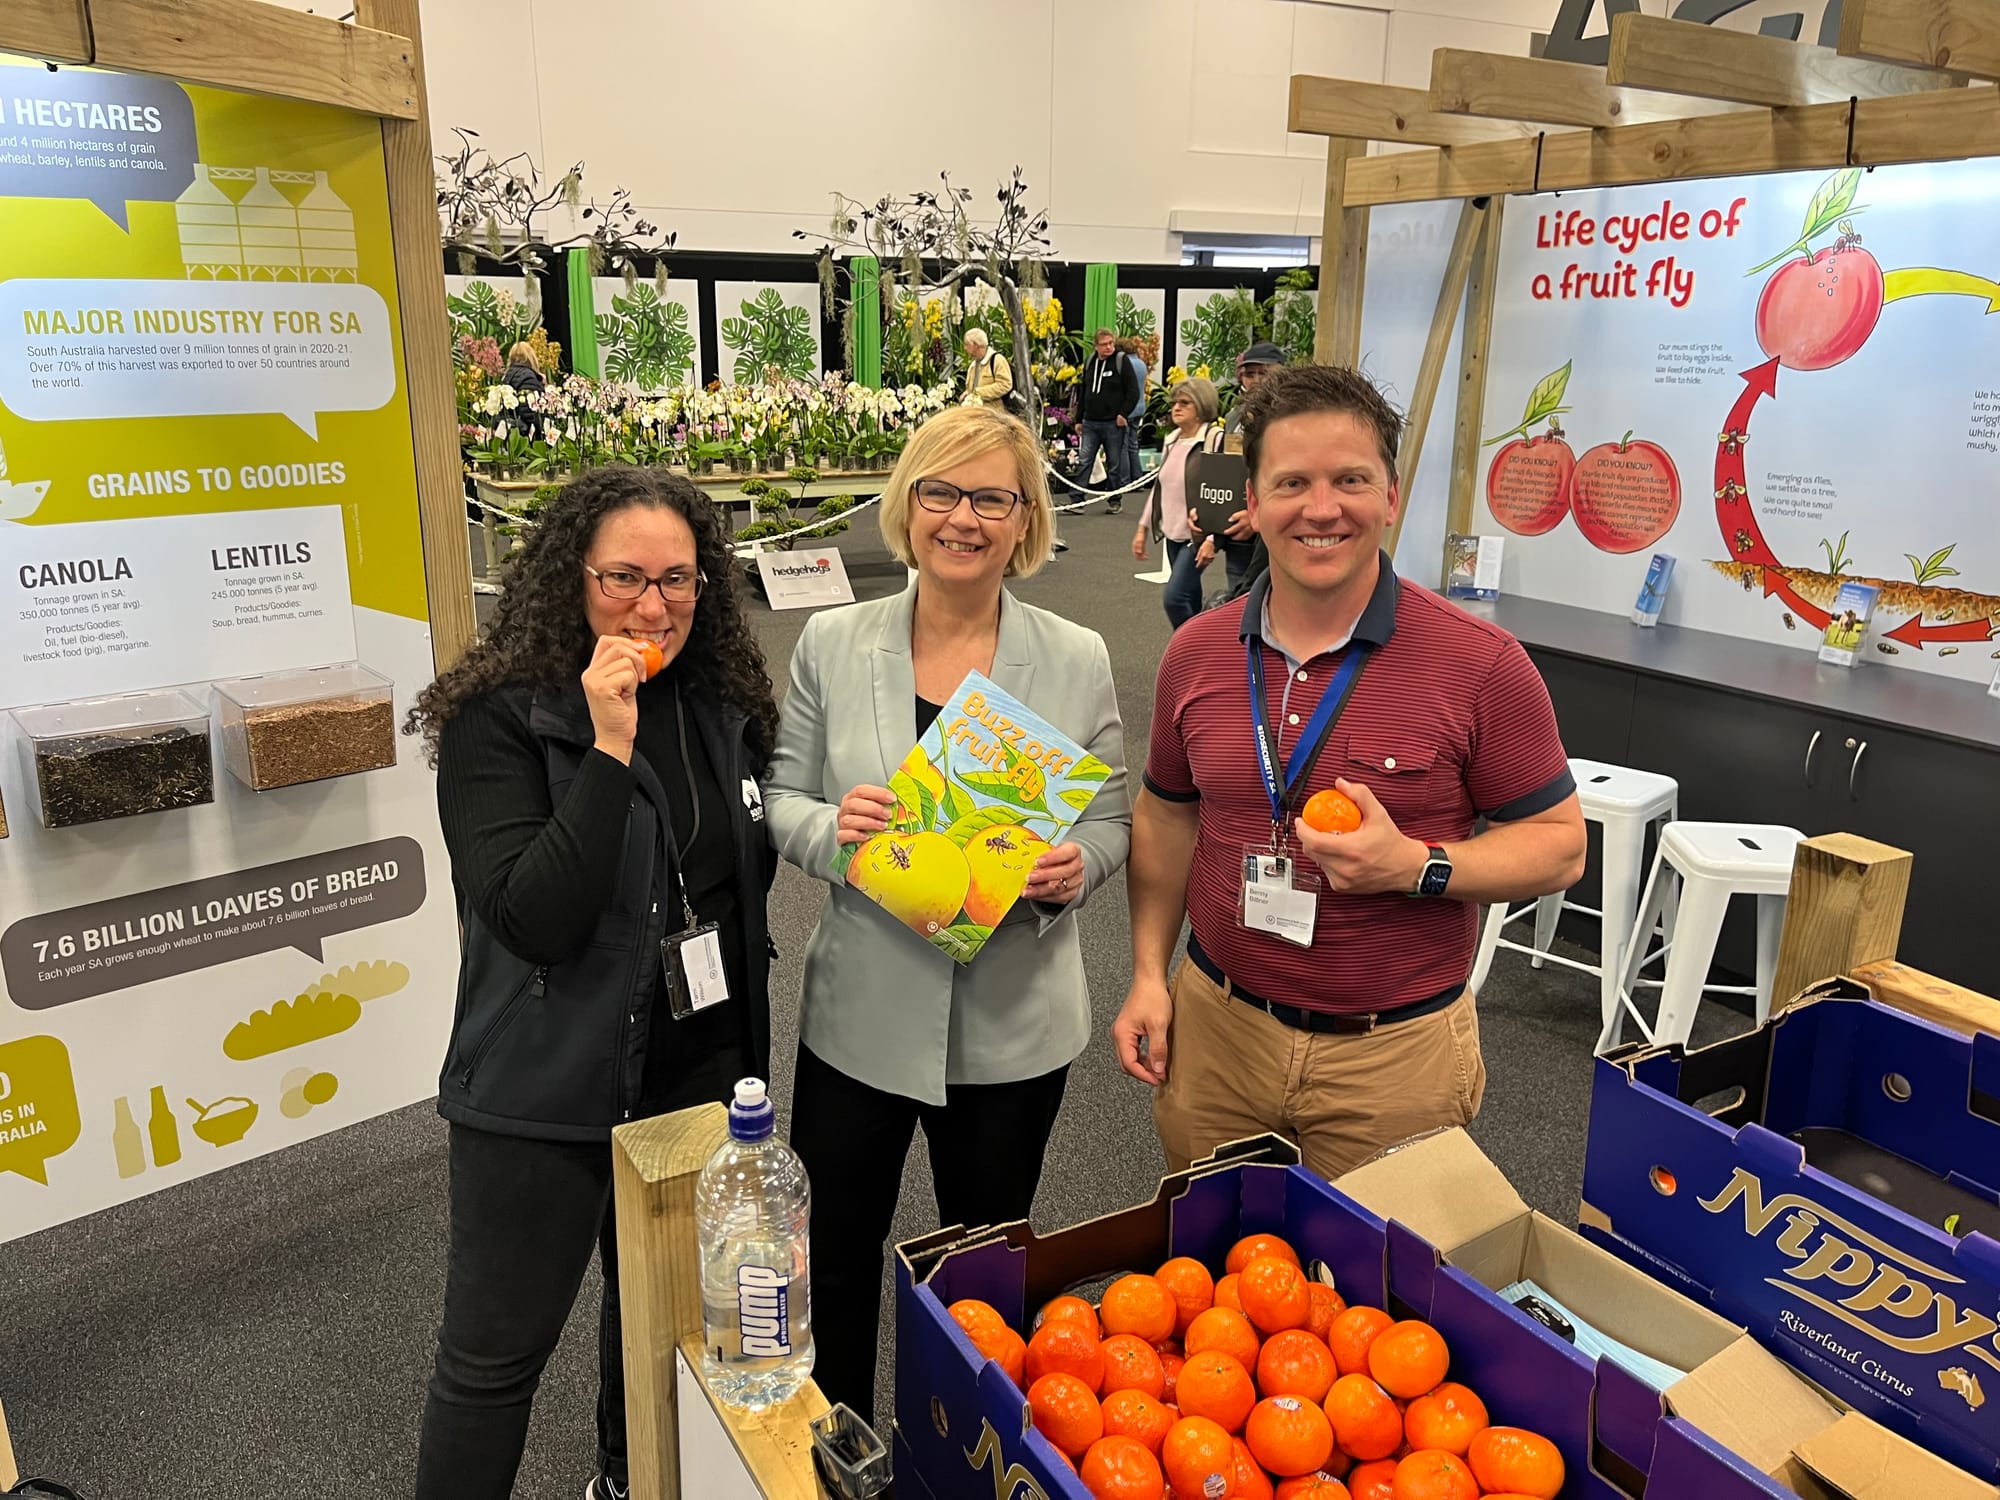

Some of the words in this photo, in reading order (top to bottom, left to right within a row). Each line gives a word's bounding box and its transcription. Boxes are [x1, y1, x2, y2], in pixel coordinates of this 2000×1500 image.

[14, 98, 162, 133] HECTARES
[20, 137, 28, 147] 4
[32, 138, 66, 150] million
[69, 138, 114, 152] hectares
[117, 141, 127, 152] of
[130, 142, 156, 155] grain
[38, 153, 73, 168] barley,
[76, 155, 106, 168] lentils
[109, 158, 128, 169] and
[131, 158, 167, 171] canola.
[1536, 209, 1596, 249] Life
[1602, 200, 1690, 254] cycle
[1699, 196, 1748, 238] of
[1532, 274, 1553, 300] a
[1560, 260, 1638, 300] fruit
[1645, 256, 1694, 308] fly
[23, 309, 125, 335] MAJOR
[133, 309, 264, 335] INDUSTRY
[273, 310, 321, 334] FOR
[329, 311, 362, 335] SA
[27, 345, 57, 357] South
[60, 344, 105, 356] Australia
[108, 344, 157, 356] harvested
[160, 346, 180, 355] over
[184, 344, 191, 355] 9
[194, 344, 225, 354] million
[228, 344, 259, 354] tonnes
[262, 344, 272, 354] of
[274, 344, 297, 356] grain
[300, 344, 308, 354] in
[1682, 352, 1693, 364] lay
[1694, 355, 1710, 364] eggs
[1690, 344, 1710, 354] stings
[30, 361, 53, 373] Over
[57, 361, 82, 372] 70%
[85, 361, 95, 372] of
[98, 360, 116, 371] this
[119, 360, 156, 371] harvest
[159, 361, 178, 370] was
[182, 358, 223, 373] exported
[226, 359, 235, 369] to
[238, 360, 258, 369] over
[260, 358, 272, 369] 50
[276, 358, 317, 369] countries
[320, 358, 350, 369] around
[32, 377, 48, 389] the
[52, 376, 84, 388] world.
[1966, 441, 1998, 452] mushy,
[1597, 458, 1608, 467] DID
[1610, 460, 1625, 469] YOU
[1626, 460, 1653, 472] KNOW?
[88, 468, 191, 499] GRAINS
[196, 466, 232, 492] TO
[240, 461, 346, 490] GOODIES
[1767, 472, 1802, 486] Emerging
[1200, 482, 1233, 504] foggo
[1778, 484, 1800, 493] settle
[1762, 506, 1778, 514] and
[1778, 507, 1797, 517] hard
[1797, 510, 1806, 518] to
[1776, 498, 1790, 506] are
[1790, 498, 1812, 508] quite
[1812, 502, 1833, 510] small
[211, 541, 312, 571] LENTILS
[19, 557, 134, 589] CANOLA
[772, 564, 831, 577] hedgehogs
[224, 578, 257, 588] Tonnage
[258, 575, 282, 586] grown
[284, 573, 290, 581] in
[247, 586, 273, 596] tonnes
[274, 585, 283, 596] (5
[284, 583, 300, 594] year
[33, 596, 70, 607] Tonnage
[72, 592, 99, 604] grown
[101, 590, 110, 599] in
[19, 608, 58, 621] 350,000
[60, 606, 89, 616] tonnes
[91, 603, 100, 614] (5
[102, 602, 120, 614] year
[122, 599, 144, 611] avg).
[46, 619, 123, 635] Products/Goodies:
[212, 619, 235, 629] Soup,
[44, 637, 59, 648] Oil,
[61, 635, 77, 646] fuel
[23, 649, 62, 663] livestock
[62, 646, 82, 658] food
[84, 645, 106, 657] (pig),
[107, 640, 152, 654] margarine.
[962, 690, 1026, 750] Buzz
[1023, 739, 1074, 778] off
[946, 717, 1009, 773] fruit
[1006, 758, 1044, 804] fly
[1256, 724, 1275, 781] BIOSECURITY
[1268, 782, 1276, 795] SA
[32, 935, 76, 964] 7.6
[82, 908, 184, 953] BILLION
[191, 886, 284, 926] LOAVES
[290, 878, 320, 903] OF
[326, 860, 400, 895] BREAD
[38, 968, 63, 982] Each
[64, 962, 86, 977] year
[88, 960, 103, 970] SA
[105, 951, 135, 968] grows
[136, 942, 172, 959] enough
[173, 934, 202, 950] wheat
[204, 932, 213, 942] to
[215, 925, 240, 939] make
[242, 918, 267, 933] about
[268, 913, 284, 926] 7.6
[285, 908, 310, 922] billion
[312, 902, 338, 915] loaves
[340, 898, 348, 909] of
[350, 892, 376, 906] bread.
[18, 1102, 35, 1119] IN
[1696, 1166, 2000, 1356] Nippy
[738, 1264, 793, 1358] pump
[780, 1318, 788, 1345] SPRING
[1780, 1310, 1862, 1365] Riverland
[1861, 1359, 1914, 1397] Citrus
